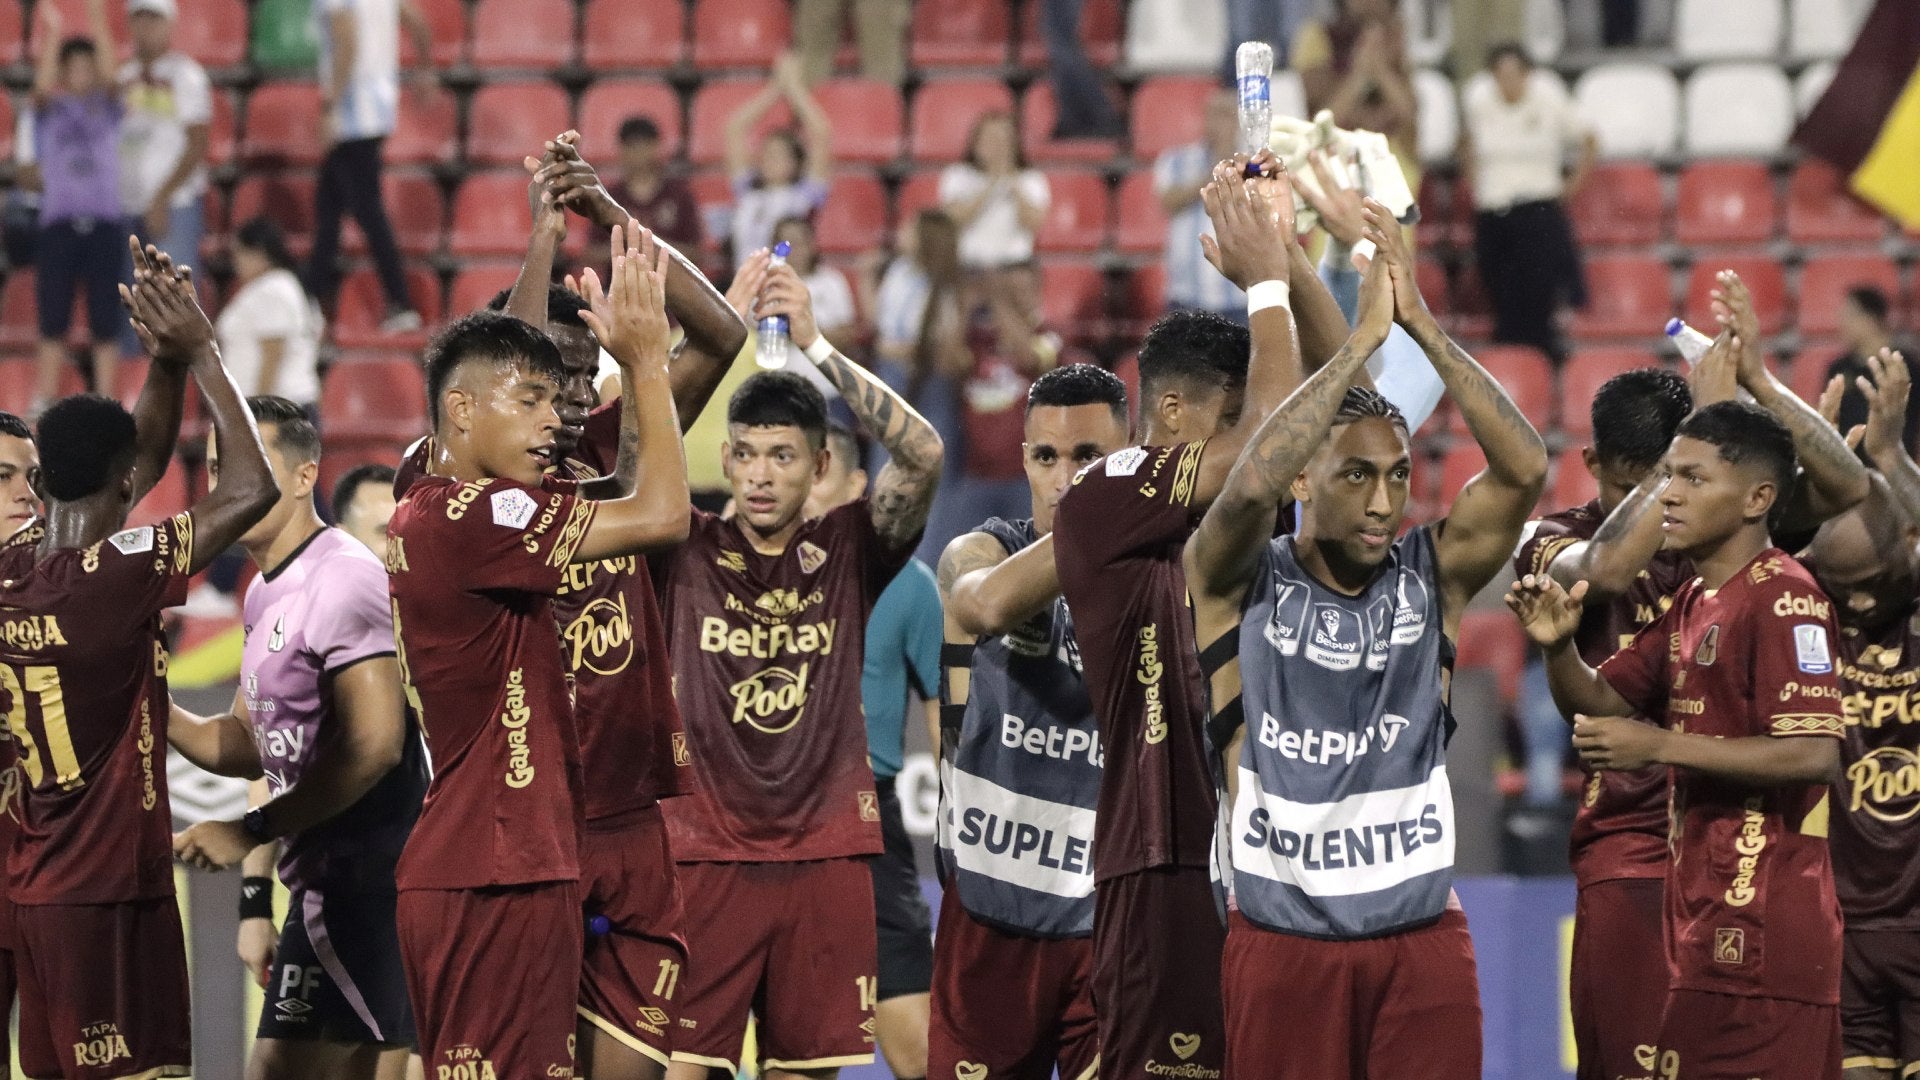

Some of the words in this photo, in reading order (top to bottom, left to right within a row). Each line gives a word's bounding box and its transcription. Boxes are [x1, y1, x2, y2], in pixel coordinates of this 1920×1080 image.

[5, 615, 68, 650] ROJA
[563, 590, 633, 672] Pool
[1316, 652, 1351, 665] DIMAYOR
[728, 661, 809, 724] Pool
[1136, 622, 1169, 745] GanaGana
[500, 666, 535, 789] GanaGana
[137, 697, 157, 811] GanaGana
[1846, 744, 1920, 812] Poo
[279, 963, 323, 1000] PF
[652, 958, 680, 1000] 11
[73, 1035, 132, 1066] ROJA
[82, 1023, 118, 1038] TAPA
[445, 1047, 482, 1061] TAPA
